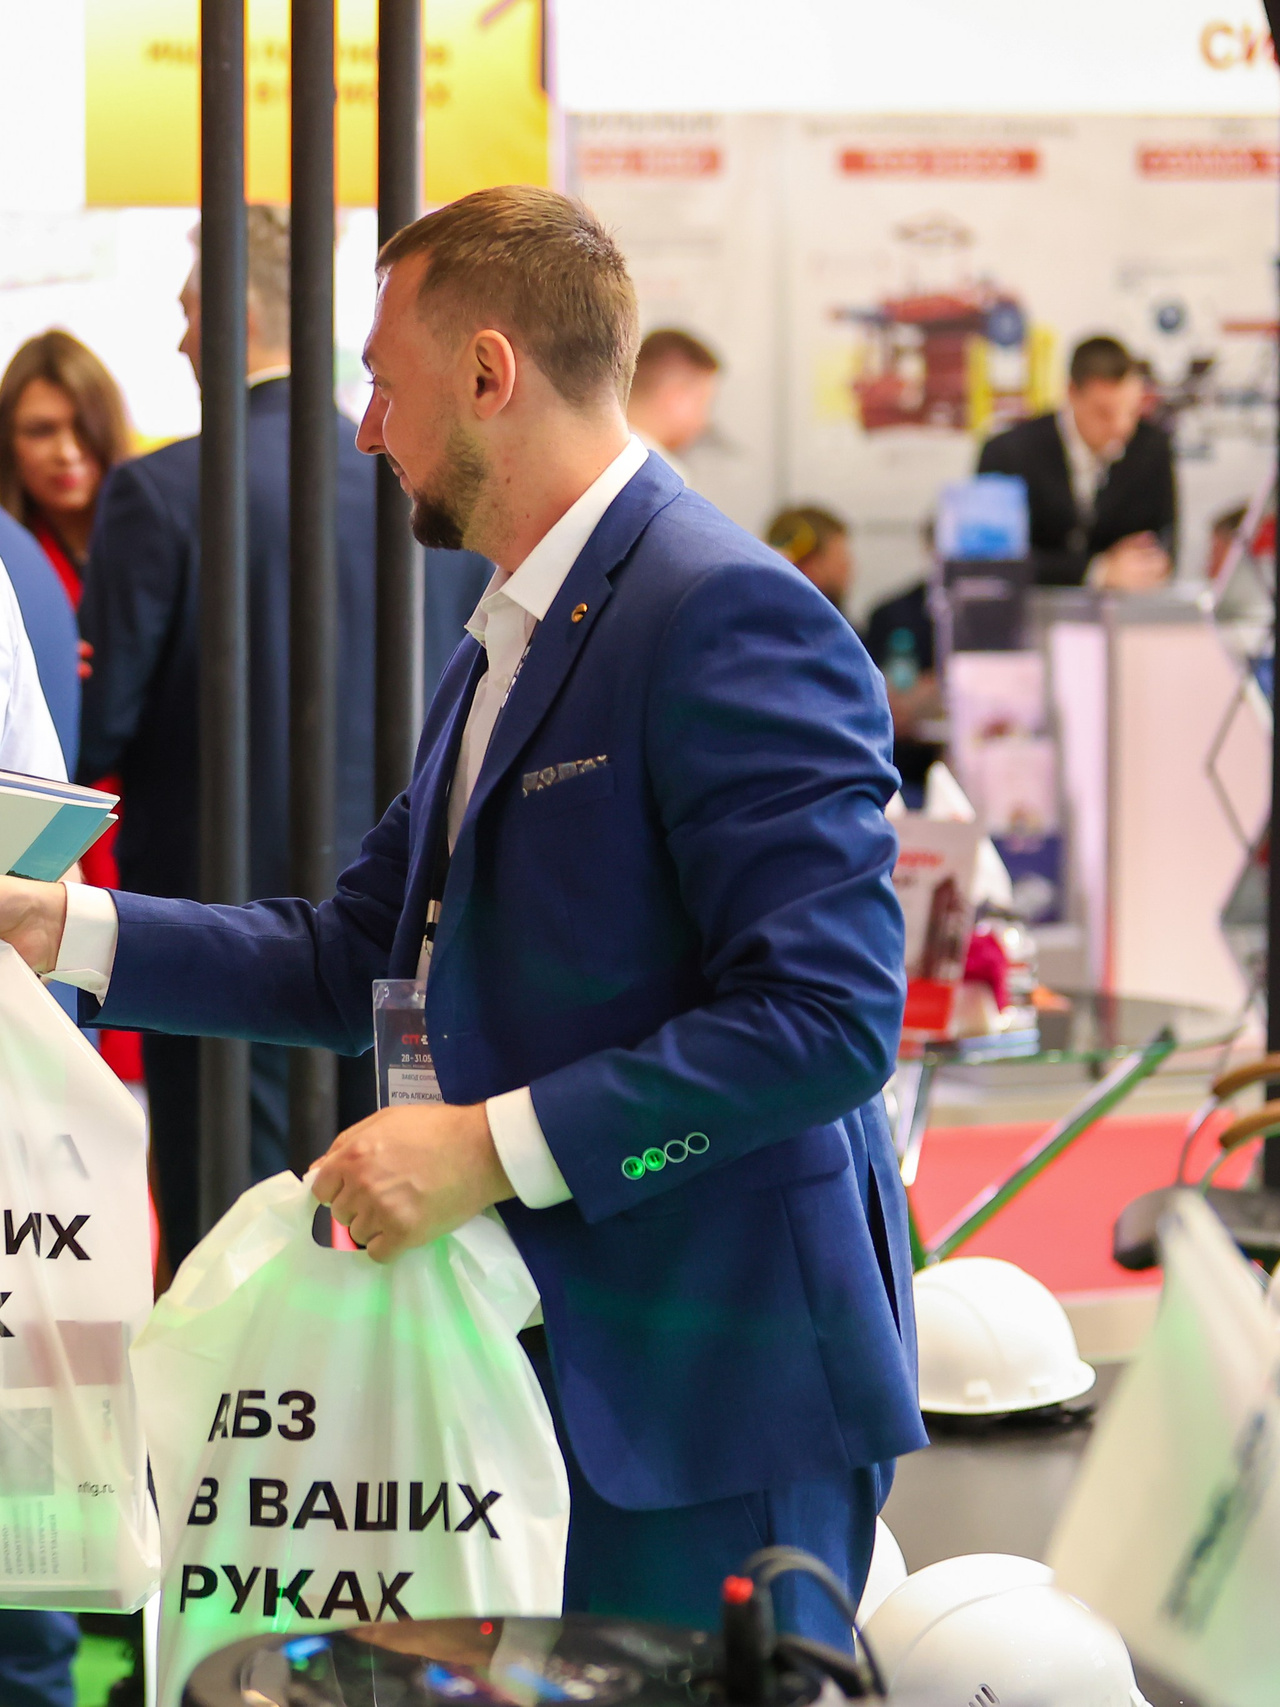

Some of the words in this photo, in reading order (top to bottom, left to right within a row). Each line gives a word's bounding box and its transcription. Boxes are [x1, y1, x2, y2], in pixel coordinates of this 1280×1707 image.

[391, 1091, 410, 1100] ИГОРЬ
[207, 1389, 317, 1442] АБЗ
[186, 1477, 219, 1525] В
[249, 1477, 503, 1540] ВАШИХ
[179, 1564, 415, 1623] РУКАХ
